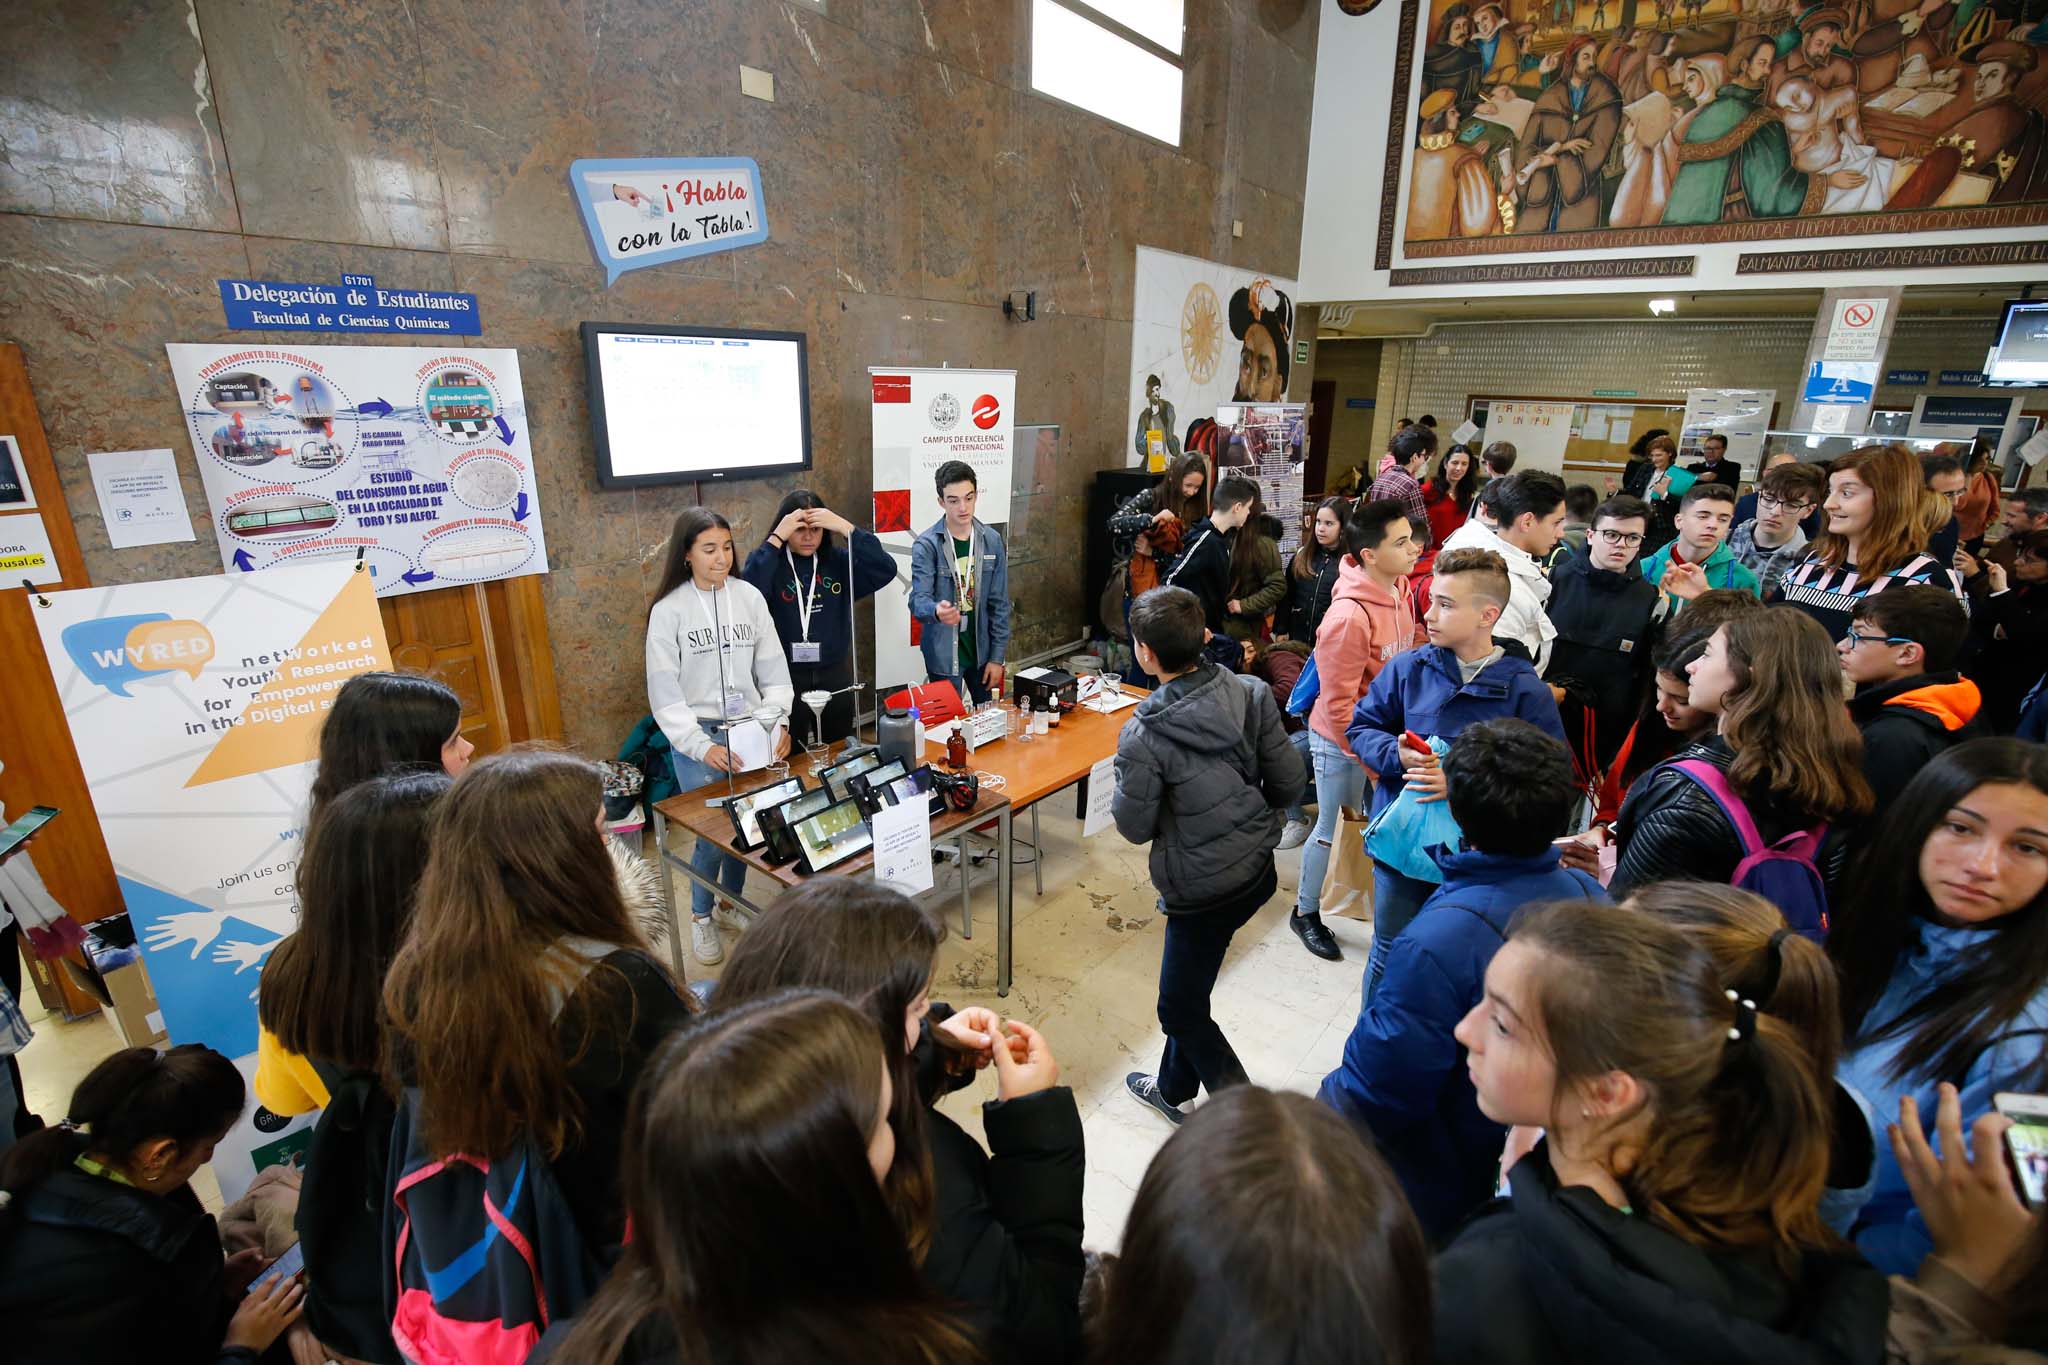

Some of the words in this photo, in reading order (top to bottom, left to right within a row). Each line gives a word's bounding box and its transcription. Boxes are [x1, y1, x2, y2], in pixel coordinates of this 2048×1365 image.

[662, 179, 747, 213] ¡Habla
[618, 230, 663, 252] con
[670, 222, 692, 242] la
[695, 210, 752, 239] Tabla!
[1863, 248, 1946, 266] ACADEMIAM
[344, 275, 373, 287] G1701
[231, 282, 338, 307] Delegación
[347, 289, 368, 306] de
[375, 290, 470, 312] Estudiantes
[252, 310, 310, 326] Facultad
[317, 313, 333, 326] de
[338, 314, 390, 328] Ciencias
[394, 316, 450, 330] Químicas
[266, 350, 281, 359] DEL
[281, 352, 325, 374] PROBLEMA
[214, 383, 248, 391] Captación
[1828, 376, 1851, 393] A
[922, 436, 953, 444] CAMPUS
[954, 435, 964, 443] DE
[965, 435, 1005, 443] EXCELENCIA
[951, 443, 1004, 452] INTERNACIONAL
[370, 470, 413, 484] ESTUDIO
[234, 484, 295, 501] CONCLUSIONES
[336, 489, 355, 501] DEL
[356, 485, 407, 500] CONSUMO
[409, 484, 421, 495] DE
[422, 482, 449, 494] AGUA
[348, 503, 361, 514] EN
[362, 502, 376, 513] LA
[376, 497, 429, 512] LOCALIDAD
[430, 496, 443, 507] DE
[357, 515, 385, 528] TORO
[386, 514, 393, 523] Y
[394, 513, 409, 524] SU
[410, 510, 440, 522] ALFOZ.
[334, 537, 379, 545] RESULTADOS
[92, 636, 210, 669] WYRED
[222, 668, 283, 690] Youth
[291, 653, 377, 678] Research
[203, 698, 231, 713] for
[185, 720, 206, 736] in
[211, 716, 245, 732] the
[250, 701, 316, 726] Digital
[217, 872, 250, 889] Join
[253, 866, 273, 879] us
